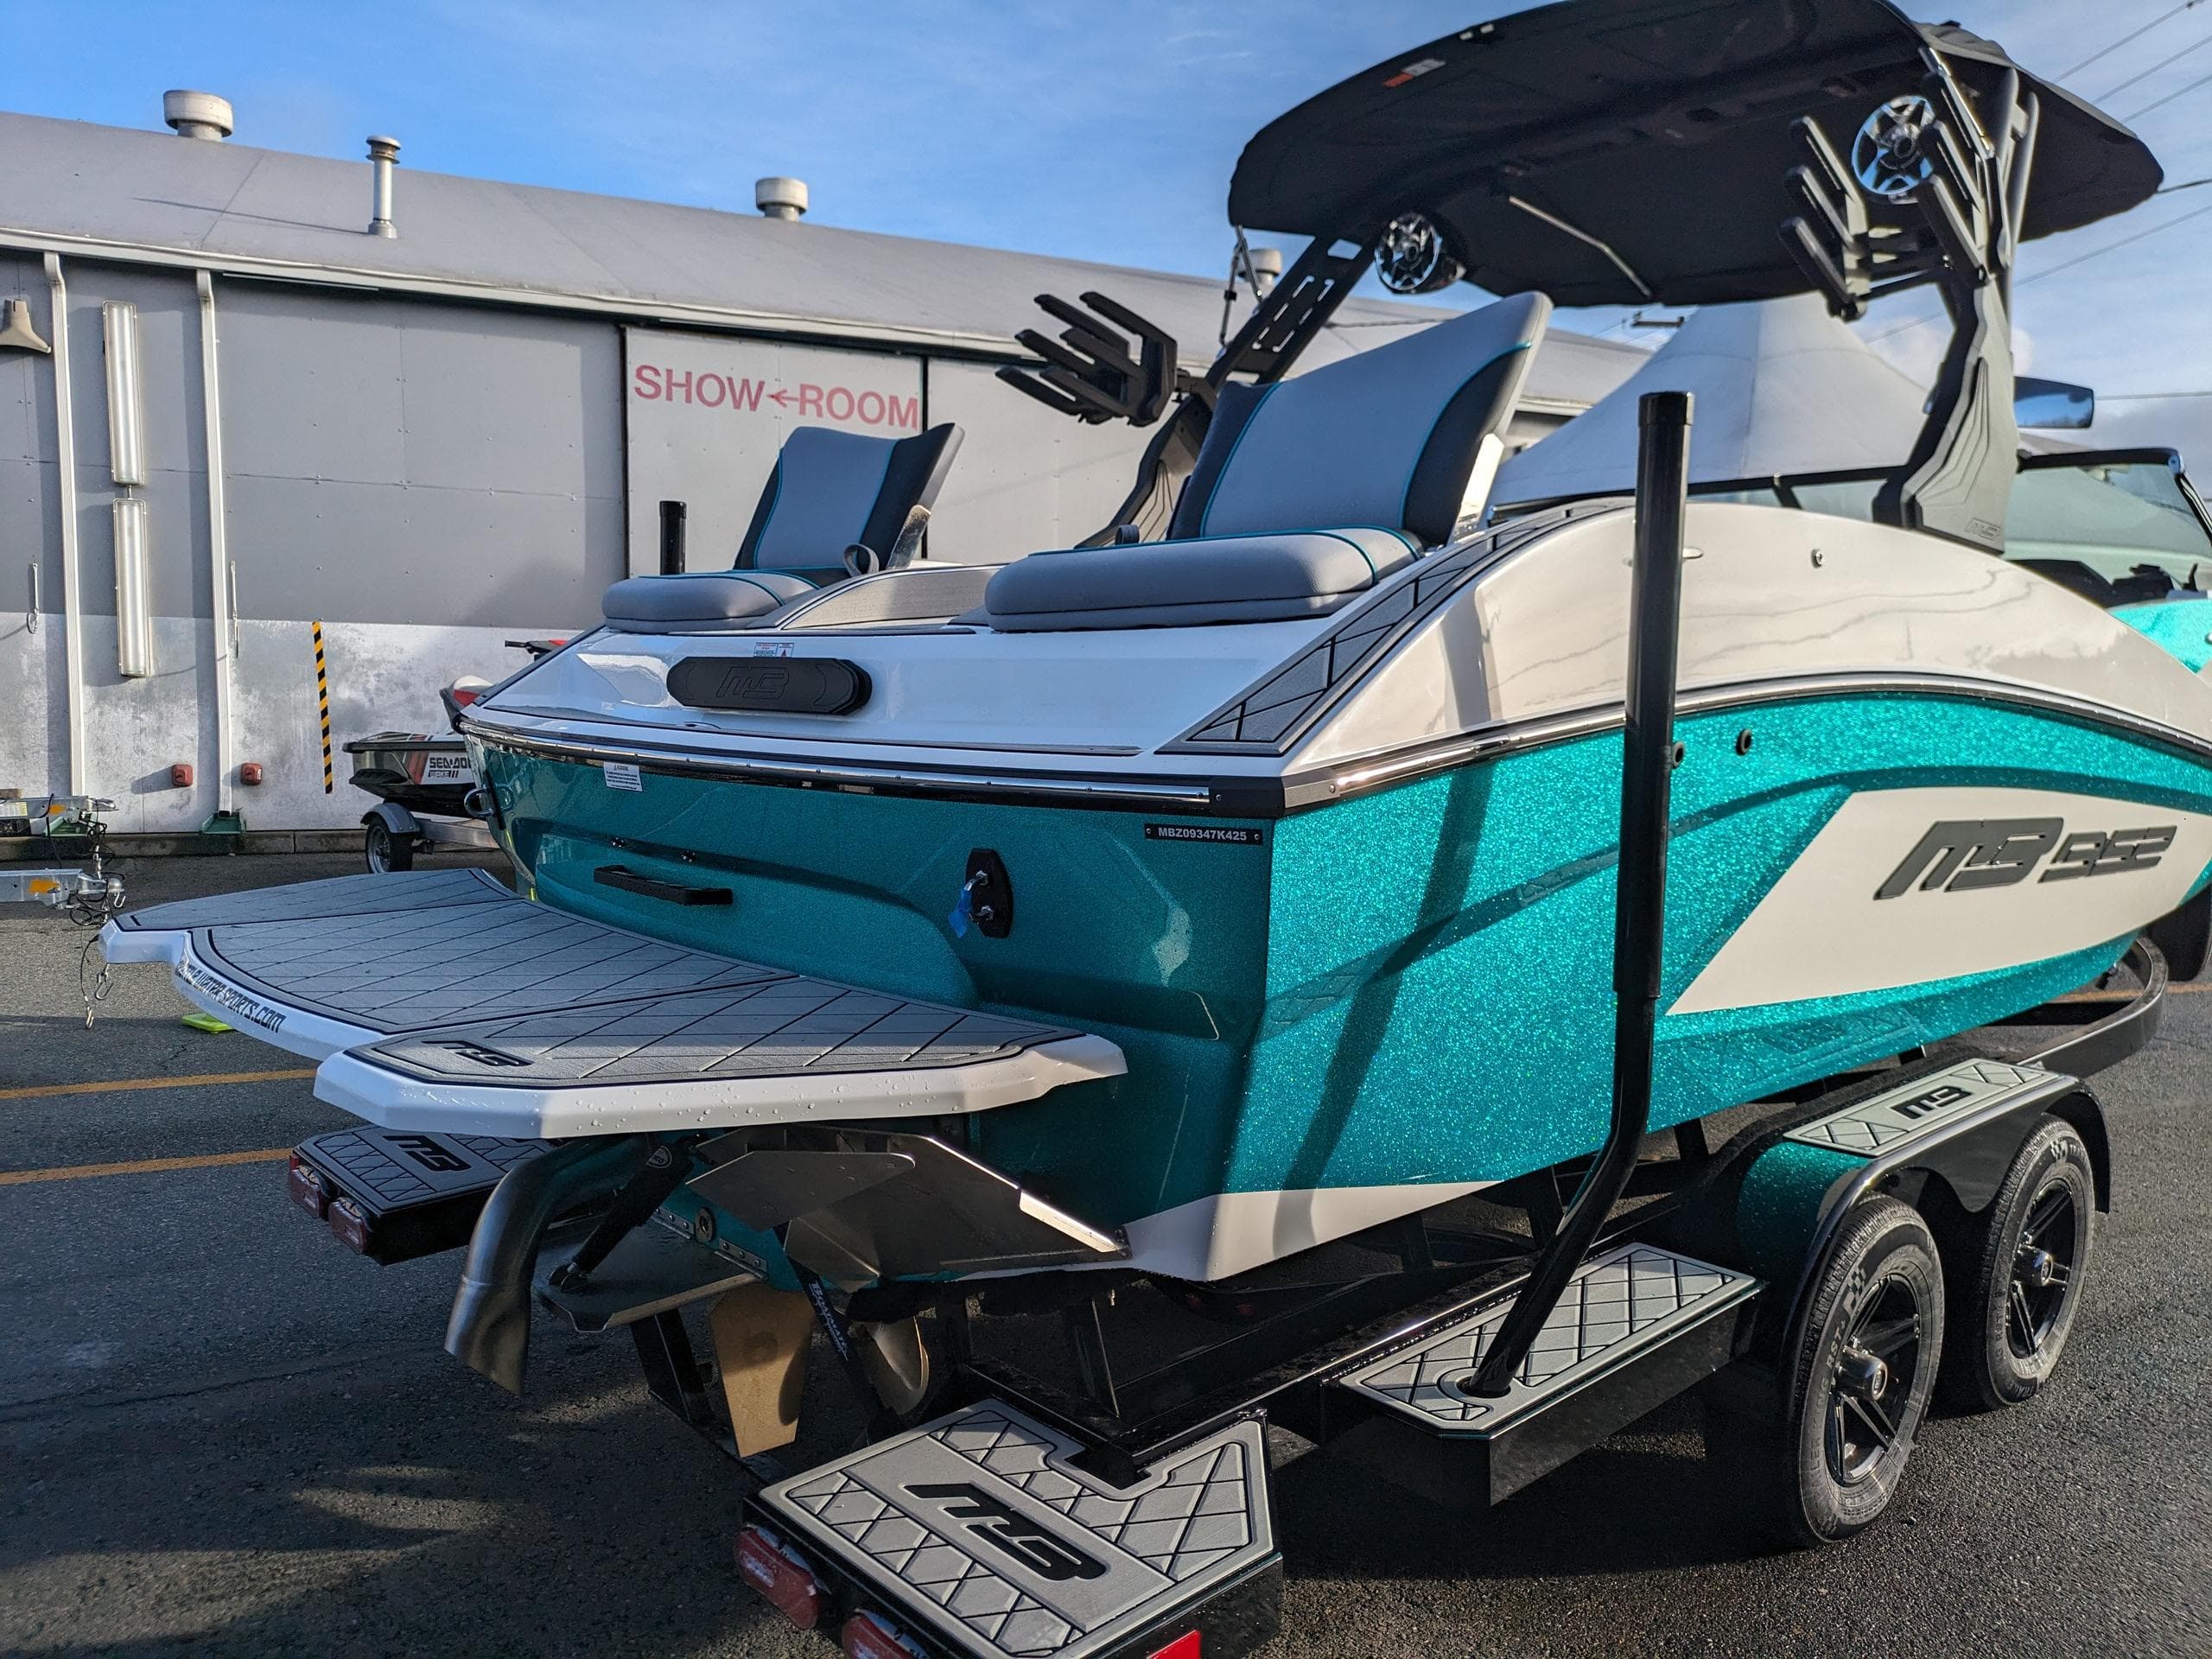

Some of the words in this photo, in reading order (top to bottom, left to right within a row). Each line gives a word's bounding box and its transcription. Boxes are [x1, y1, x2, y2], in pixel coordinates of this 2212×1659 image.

[634, 365, 766, 412] SHOW
[798, 383, 918, 430] ROOM
[1158, 827, 1247, 841] MBZ09347K425
[1873, 817, 2064, 900] MB
